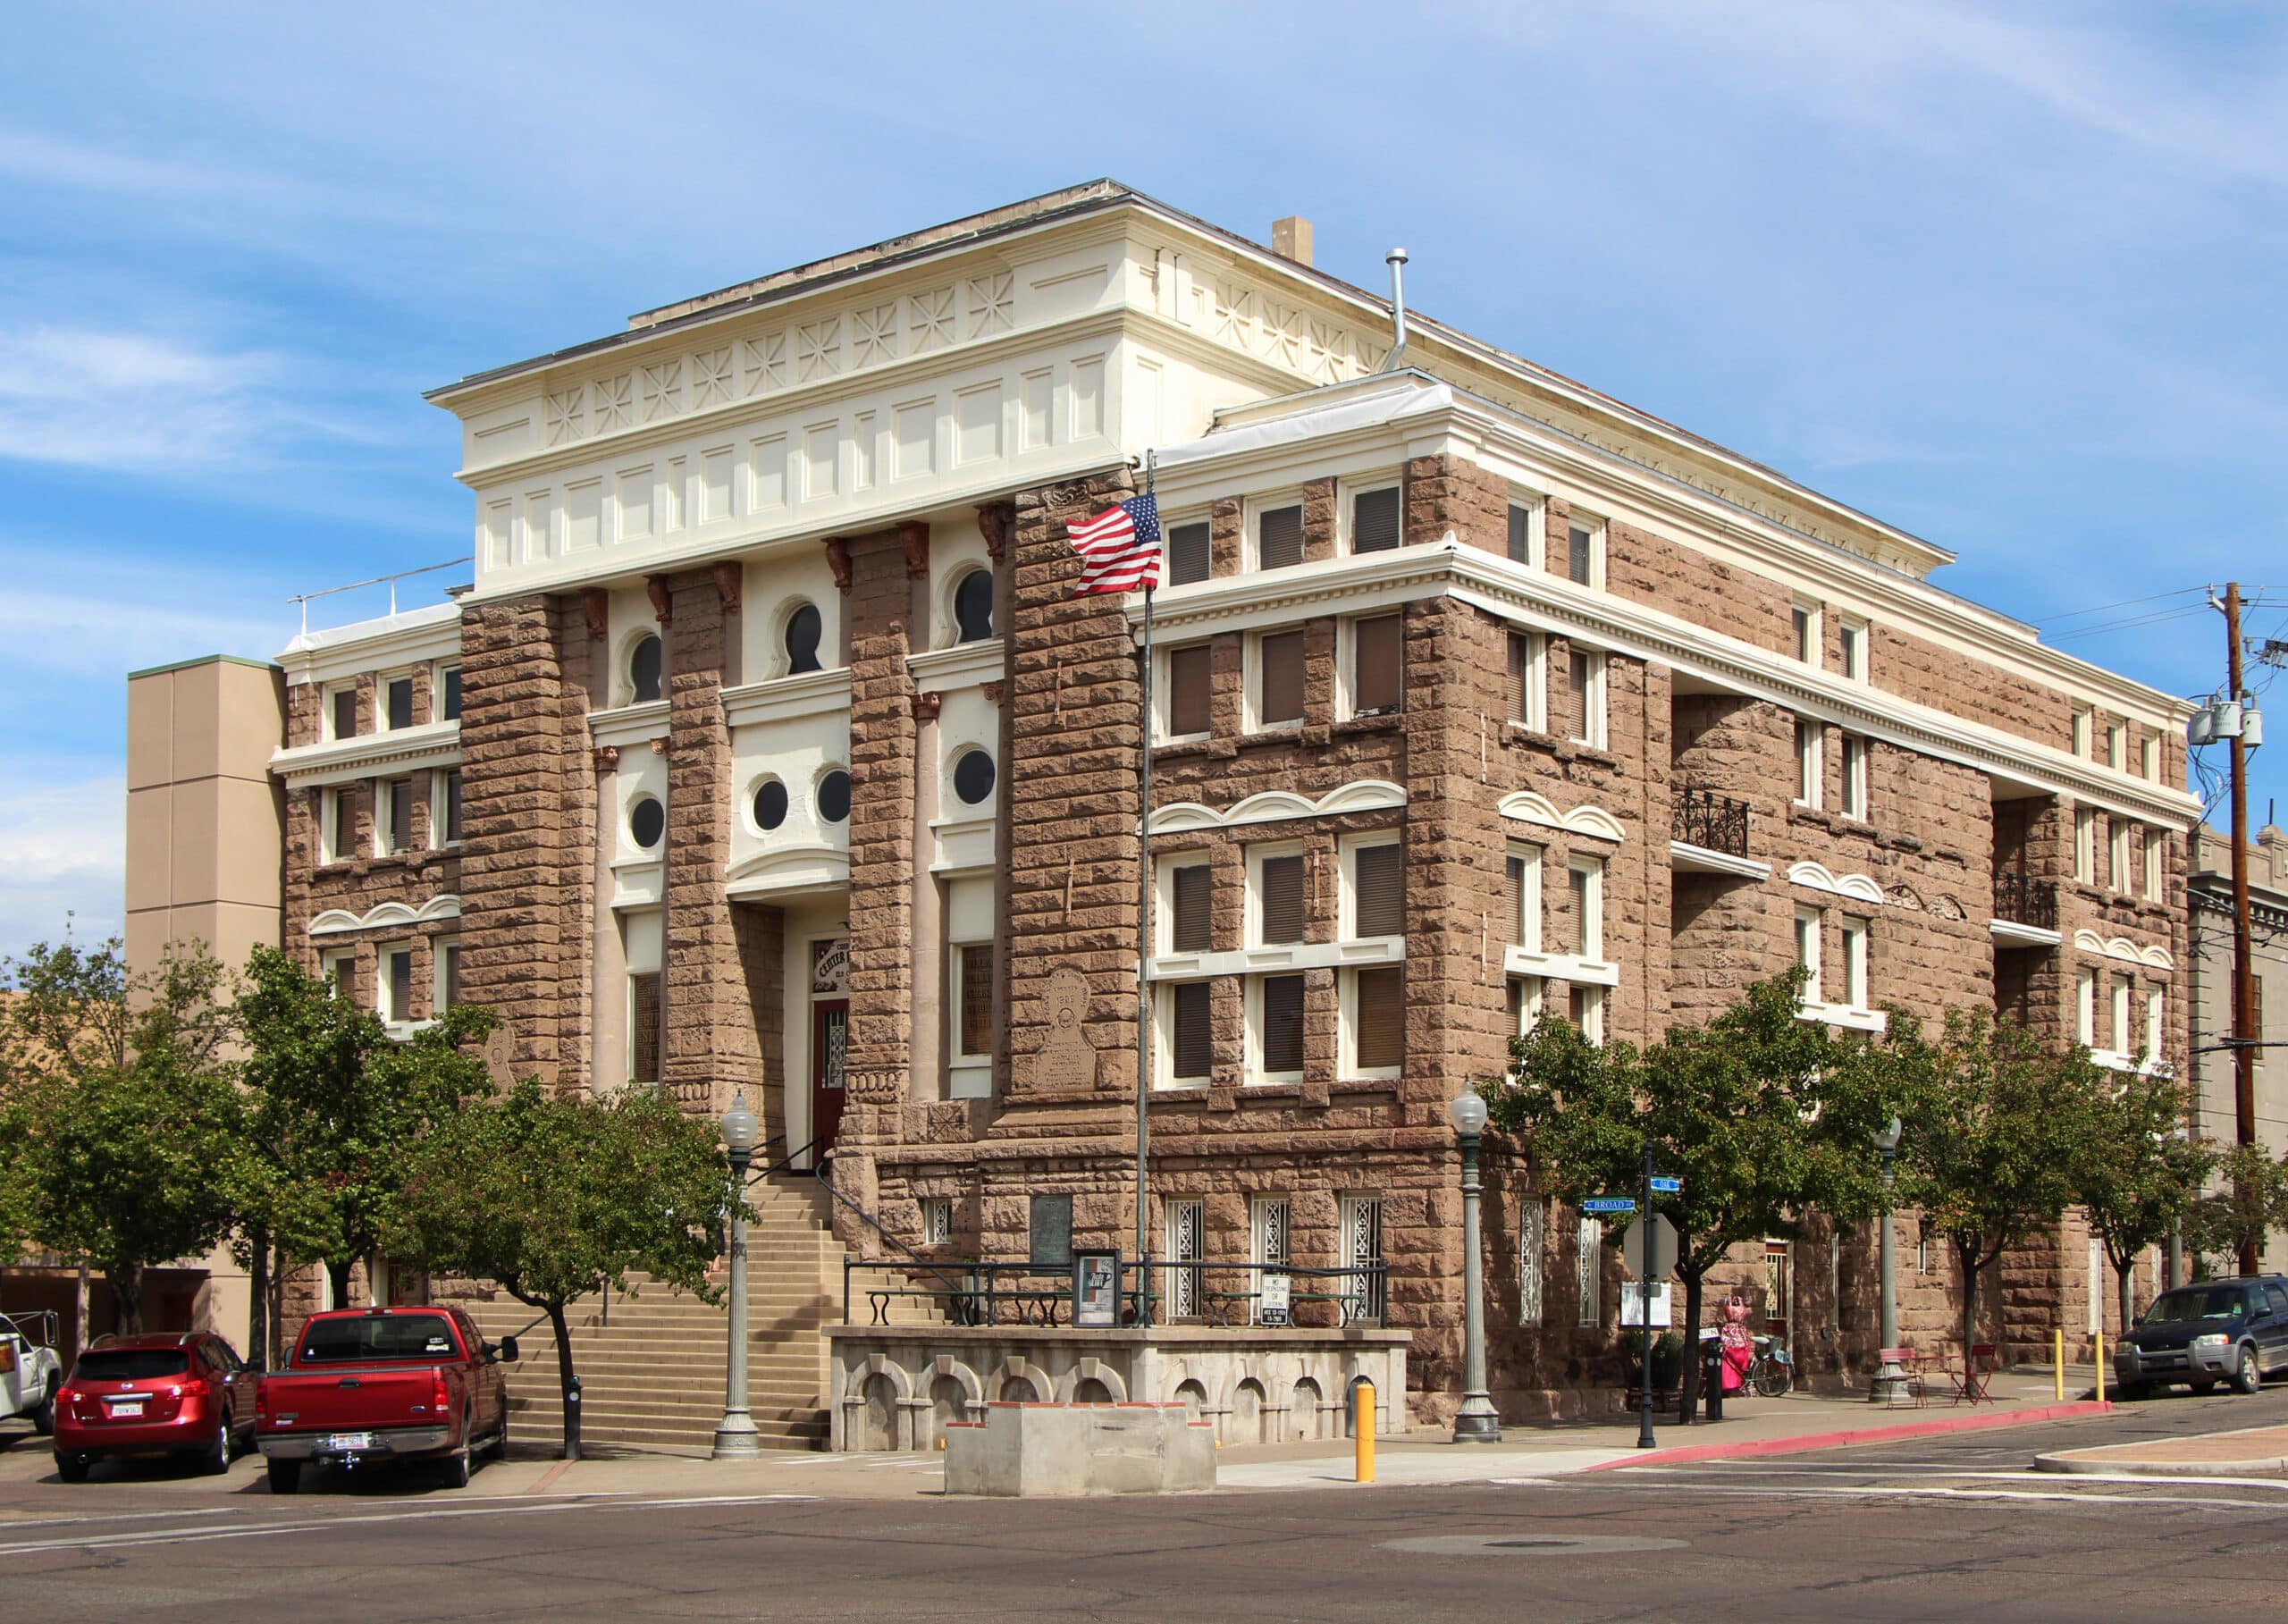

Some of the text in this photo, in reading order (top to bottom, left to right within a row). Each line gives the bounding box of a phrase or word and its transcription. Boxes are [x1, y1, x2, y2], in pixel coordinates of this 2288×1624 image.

[819, 951, 845, 977] CENTER
[1659, 1179, 1670, 1189] OAK
[1594, 1200, 1625, 1209] BROAD
[1272, 1278, 1280, 1286] NO
[1271, 1292, 1279, 1300] OR
